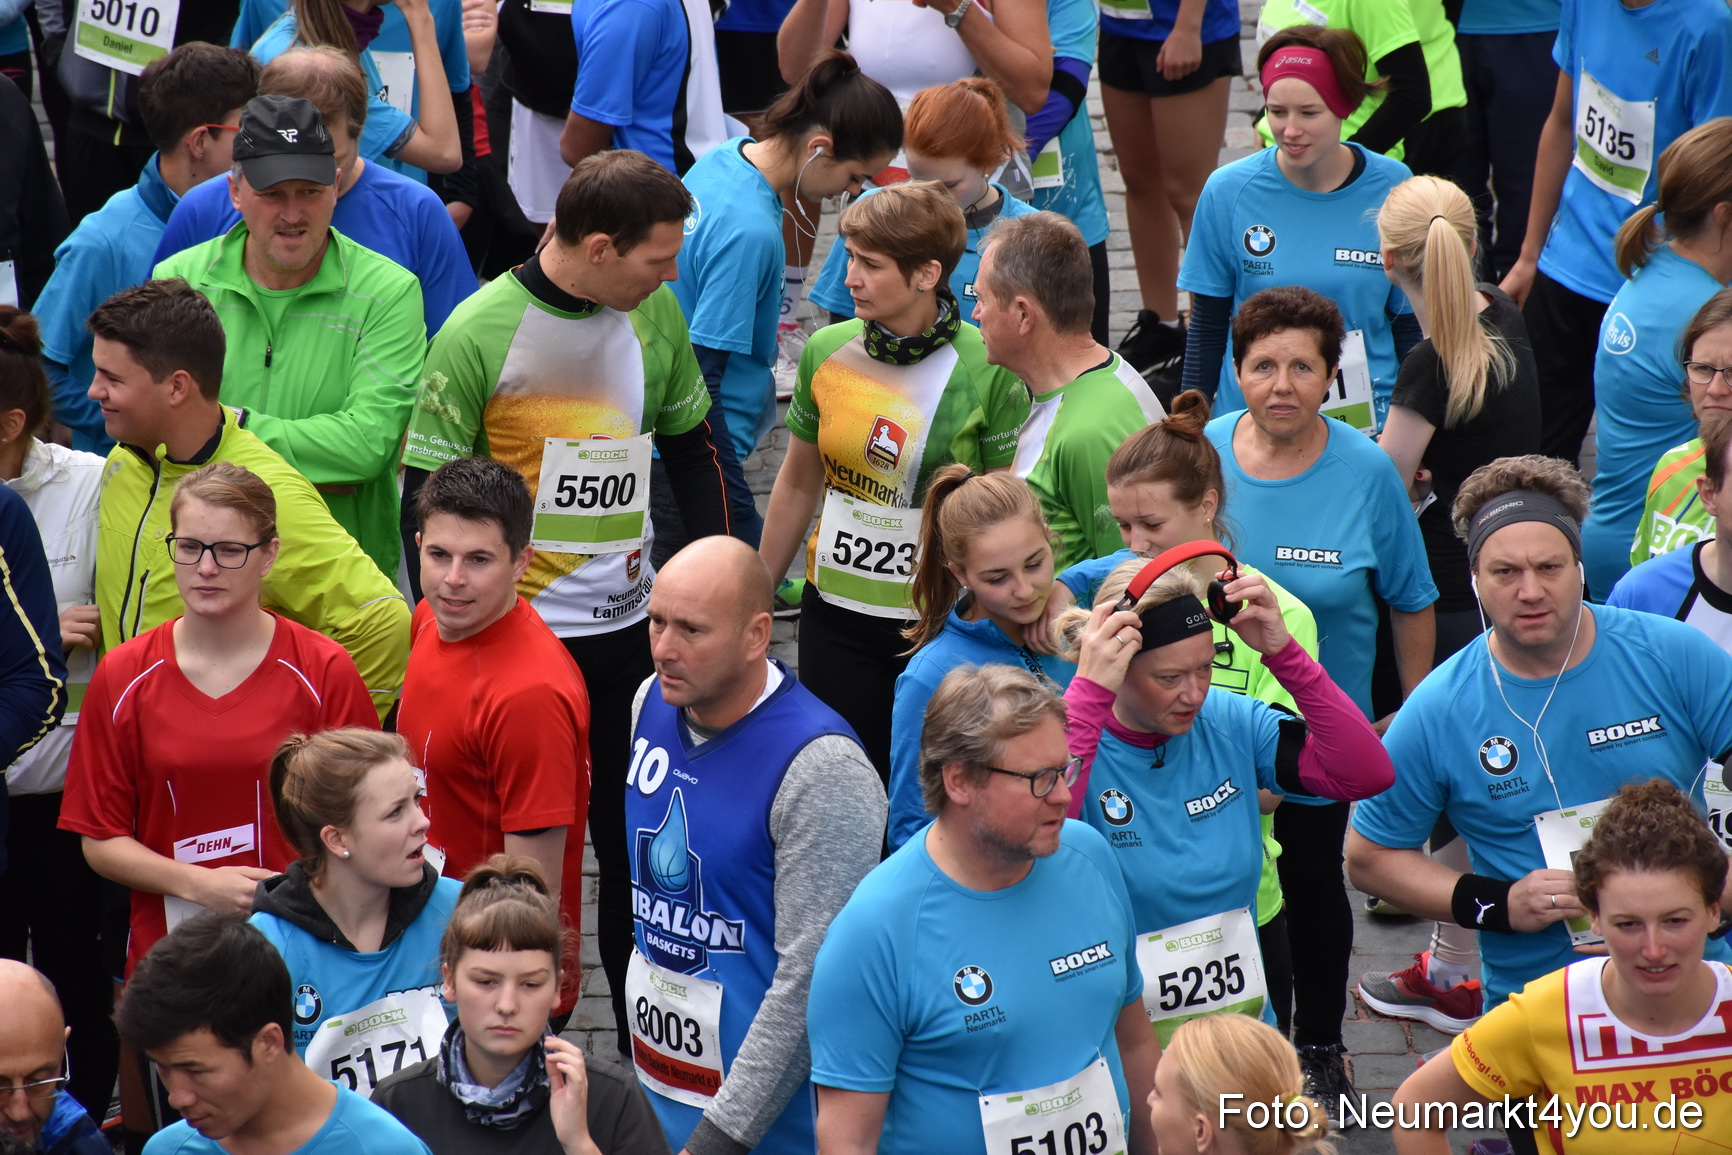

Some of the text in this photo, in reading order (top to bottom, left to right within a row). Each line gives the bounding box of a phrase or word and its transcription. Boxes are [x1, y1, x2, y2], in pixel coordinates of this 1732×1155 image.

[91, 0, 160, 37] 5010
[103, 36, 133, 54] Daniel
[1585, 105, 1636, 160] 5135
[1594, 155, 1614, 177] David
[1243, 260, 1274, 270] PARTL
[590, 449, 628, 460] BOCK
[872, 457, 890, 470] 1628
[554, 472, 636, 509] 5500
[862, 512, 903, 528] BOCK
[832, 530, 918, 576] 5223
[1276, 546, 1341, 564] BOCK
[1587, 715, 1662, 746] BOCK
[1590, 743, 1614, 753] inspired
[1624, 738, 1642, 746] smart
[626, 737, 670, 794] 10
[1487, 776, 1528, 794] PARTL
[1491, 785, 1530, 801] Neumarkt
[1185, 779, 1238, 816] BOCK
[196, 836, 232, 854] DEHN
[646, 931, 696, 960] BASKETS
[1179, 928, 1223, 949] BOCK
[1050, 942, 1112, 975] BOCK
[655, 977, 688, 998] BOCK
[1158, 953, 1245, 1011] 5235
[358, 1008, 407, 1032] BOCK
[636, 996, 703, 1058] 8003
[963, 1005, 1005, 1026] PARTL
[966, 1015, 1007, 1034] Neumarkt
[331, 1036, 428, 1092] 5171
[1040, 1087, 1082, 1113] BOCK
[1575, 1080, 1660, 1109] MAX
